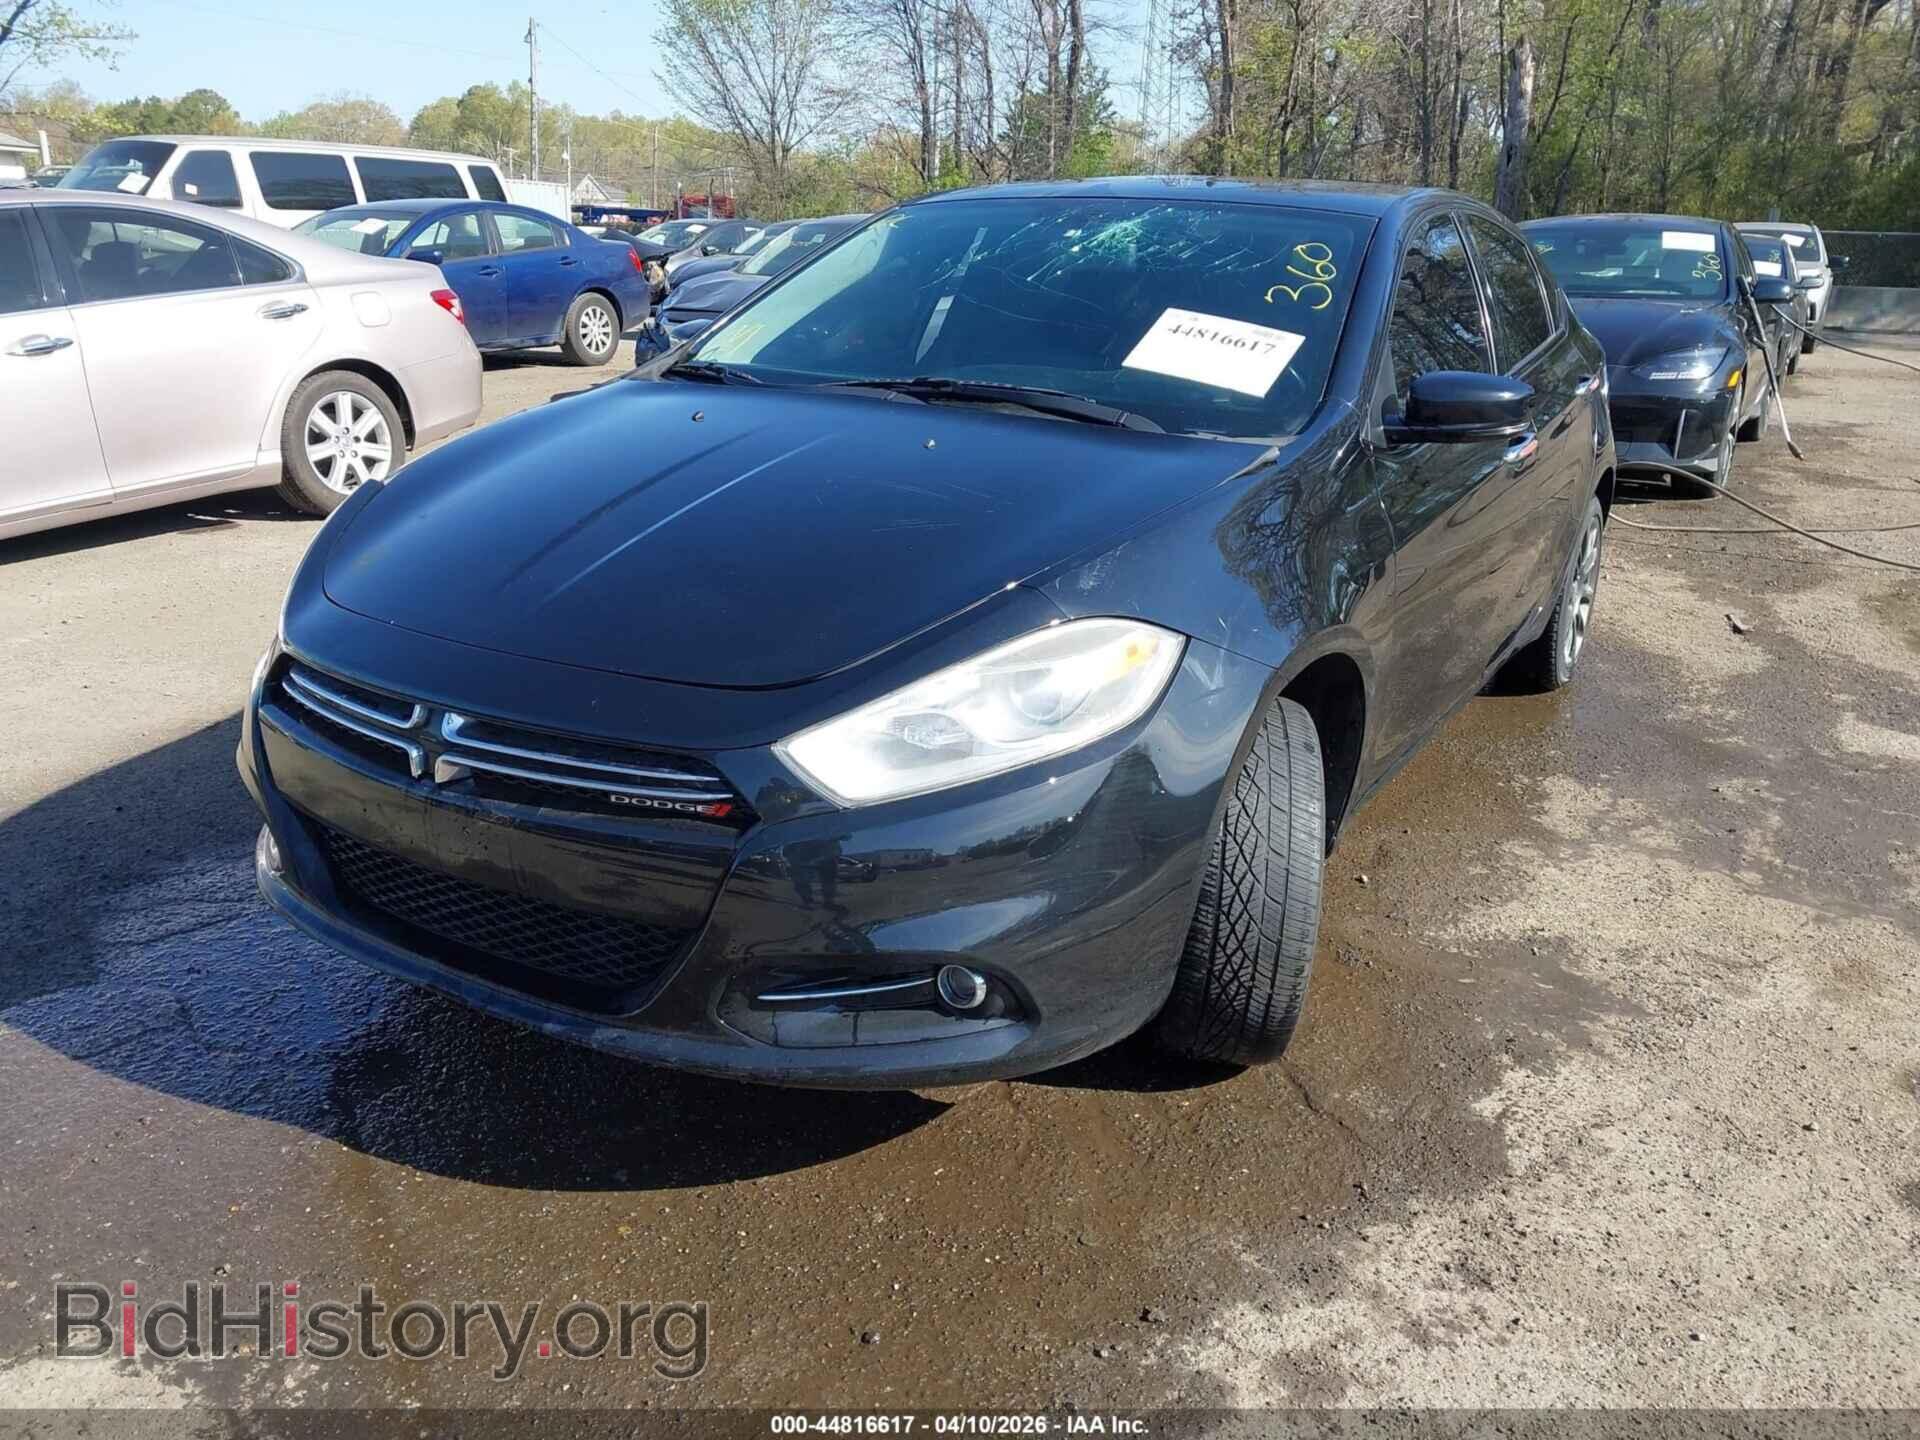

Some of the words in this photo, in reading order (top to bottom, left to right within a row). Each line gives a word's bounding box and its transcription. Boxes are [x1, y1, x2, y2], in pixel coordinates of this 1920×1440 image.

[1264, 243, 1337, 309] 360
[1692, 254, 1722, 280] 360
[1167, 323, 1277, 354] 44816617
[609, 794, 716, 814] DODGE
